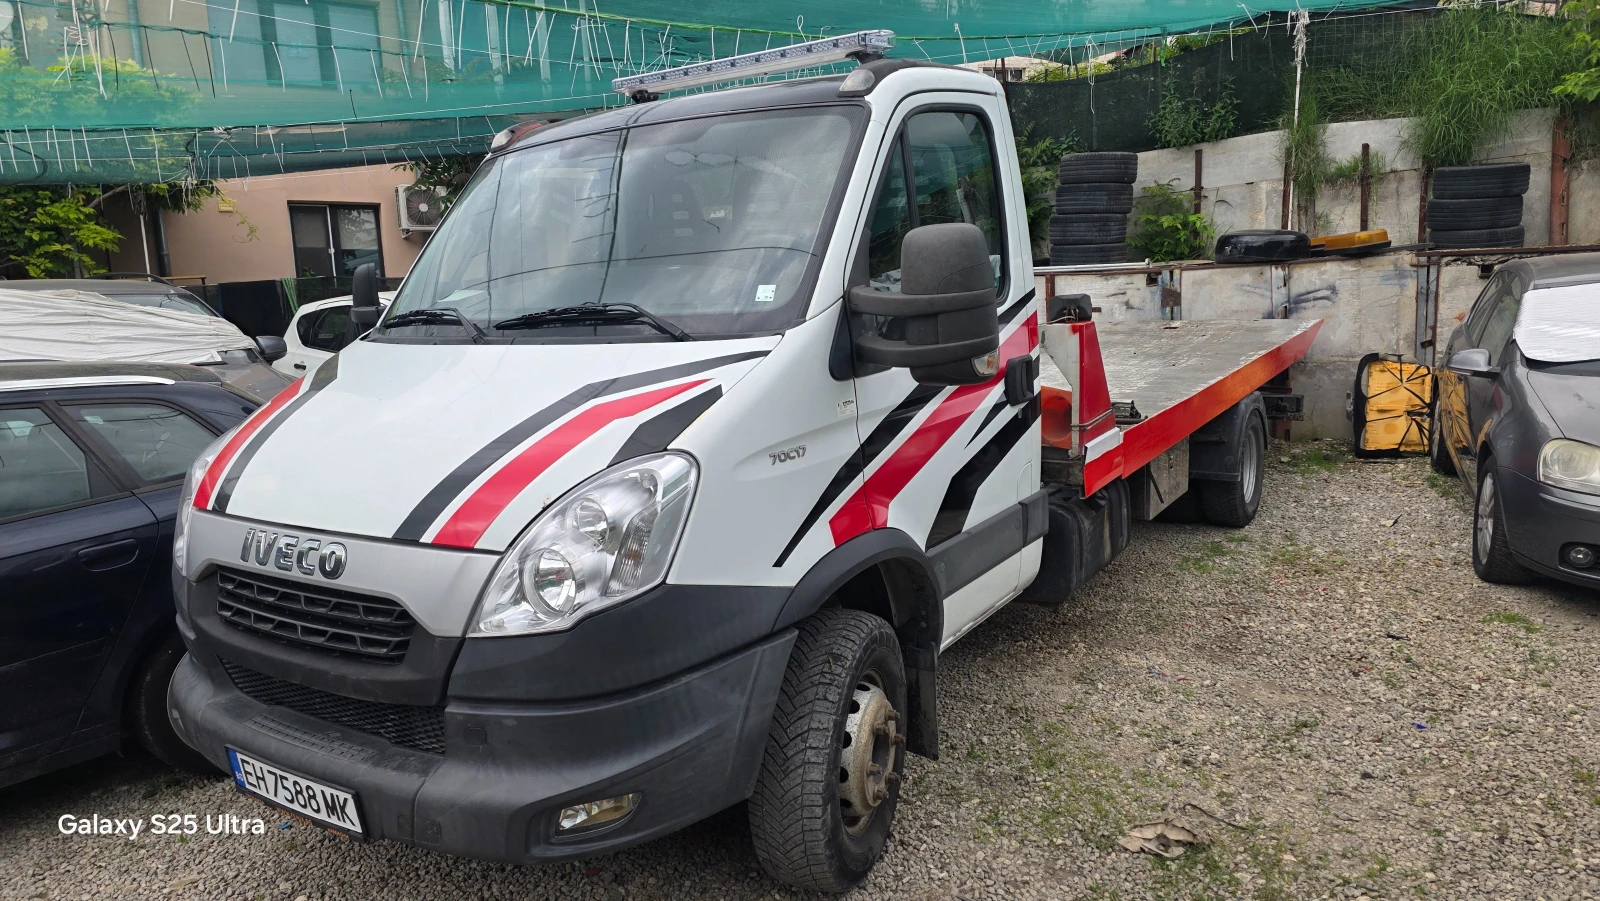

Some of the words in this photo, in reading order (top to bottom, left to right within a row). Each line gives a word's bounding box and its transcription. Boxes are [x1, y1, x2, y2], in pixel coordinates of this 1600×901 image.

[769, 444, 807, 466] 70C17
[240, 528, 347, 580] IVECO
[321, 789, 357, 827] MK
